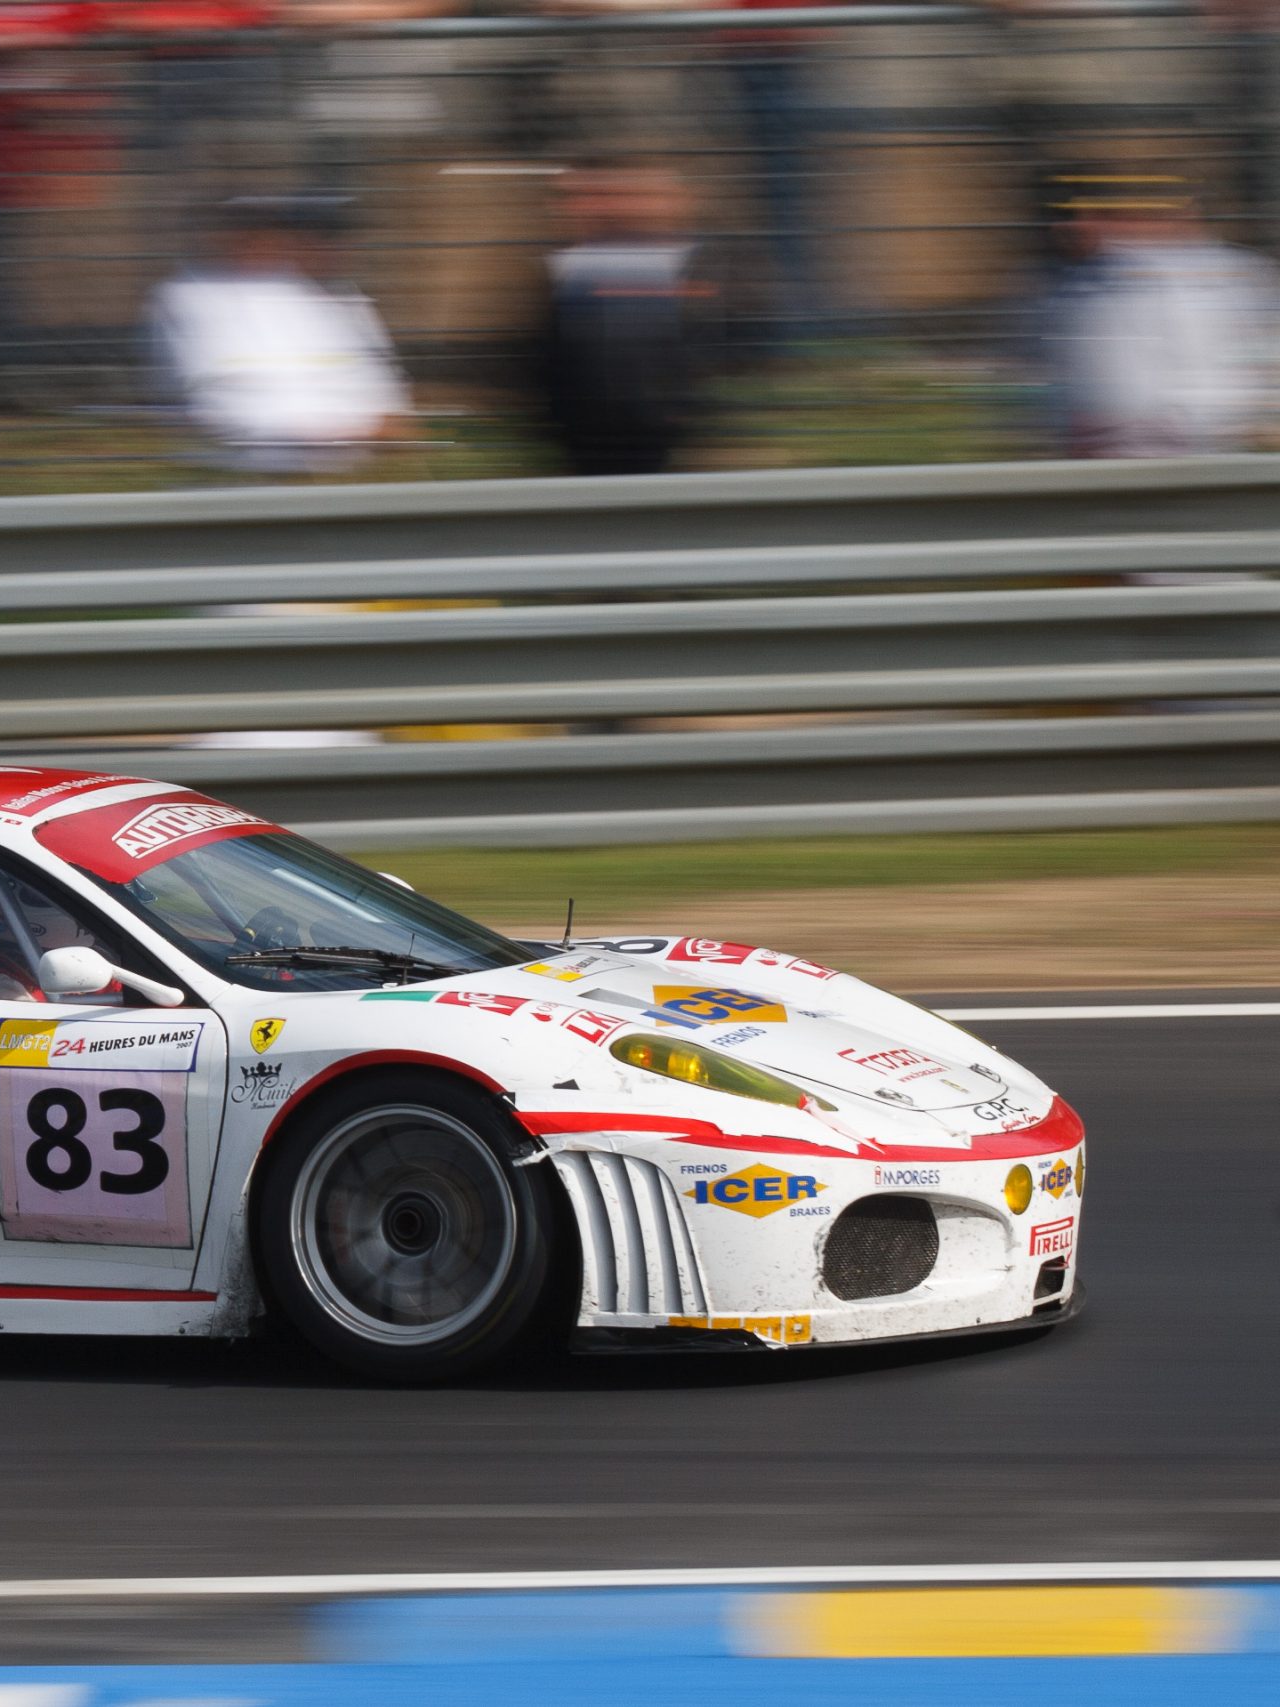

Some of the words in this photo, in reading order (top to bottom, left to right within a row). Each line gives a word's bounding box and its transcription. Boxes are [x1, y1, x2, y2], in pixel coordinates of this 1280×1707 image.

[567, 1009, 621, 1045] LK
[710, 1025, 768, 1048] FRENOS
[0, 1033, 52, 1051] LMGT2
[51, 1037, 87, 1057] 24
[89, 1037, 136, 1053] HEURES
[138, 1034, 157, 1047] DU
[158, 1029, 196, 1044] MANS
[25, 1087, 170, 1195] 83
[681, 1164, 728, 1174] FRENOS
[1041, 1166, 1072, 1192] ICER
[694, 1175, 818, 1204] ICER
[789, 1206, 831, 1217] BRAKES
[1029, 1215, 1075, 1257] PIRELLI
